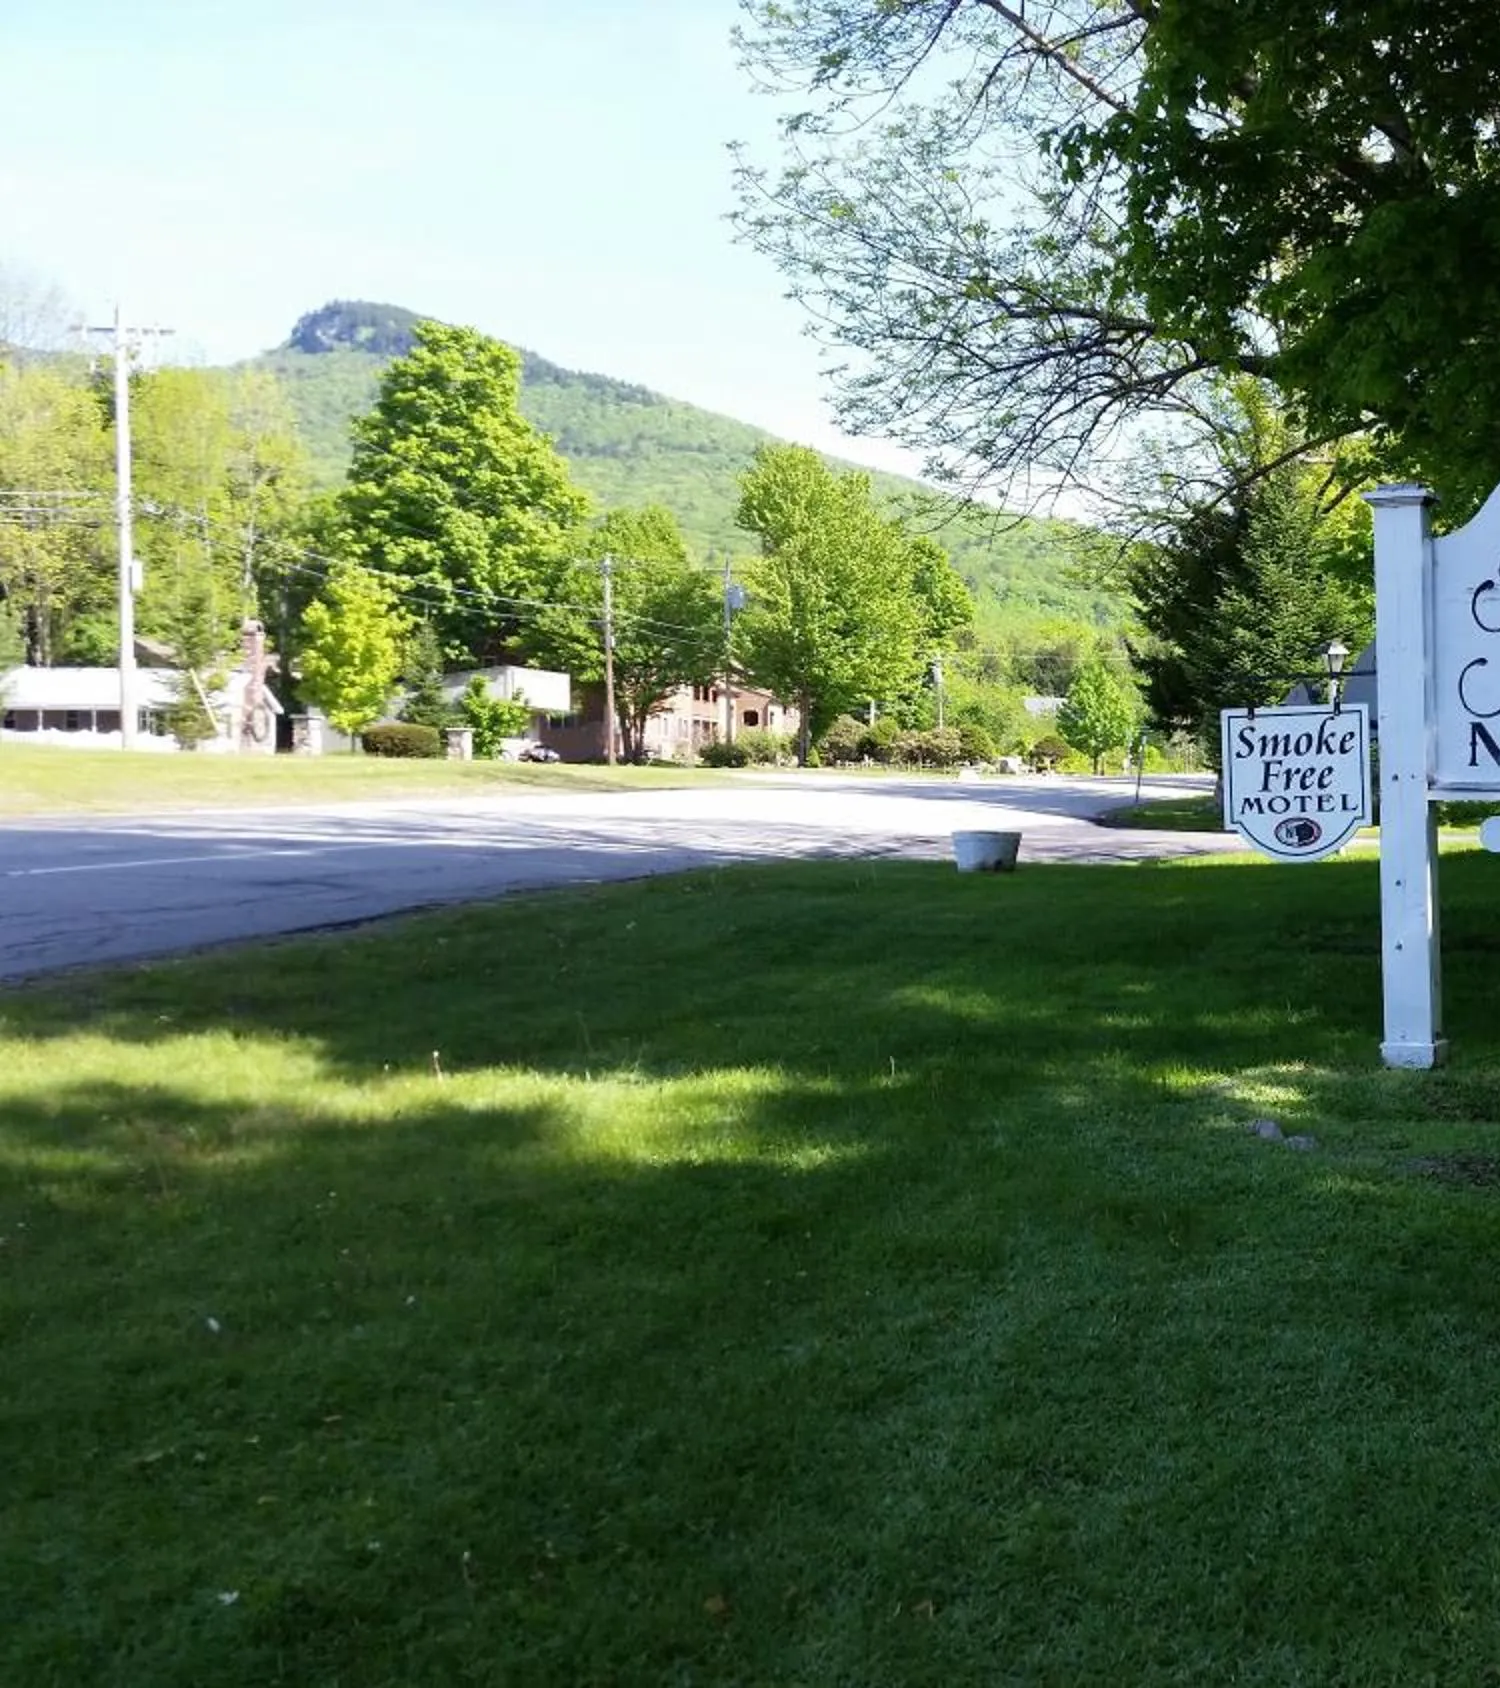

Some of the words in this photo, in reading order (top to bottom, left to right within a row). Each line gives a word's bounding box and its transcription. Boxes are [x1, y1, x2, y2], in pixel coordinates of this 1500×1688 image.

[1235, 716, 1355, 759] Smoke
[1259, 759, 1334, 793] Free
[1240, 793, 1358, 815] MOTEL
